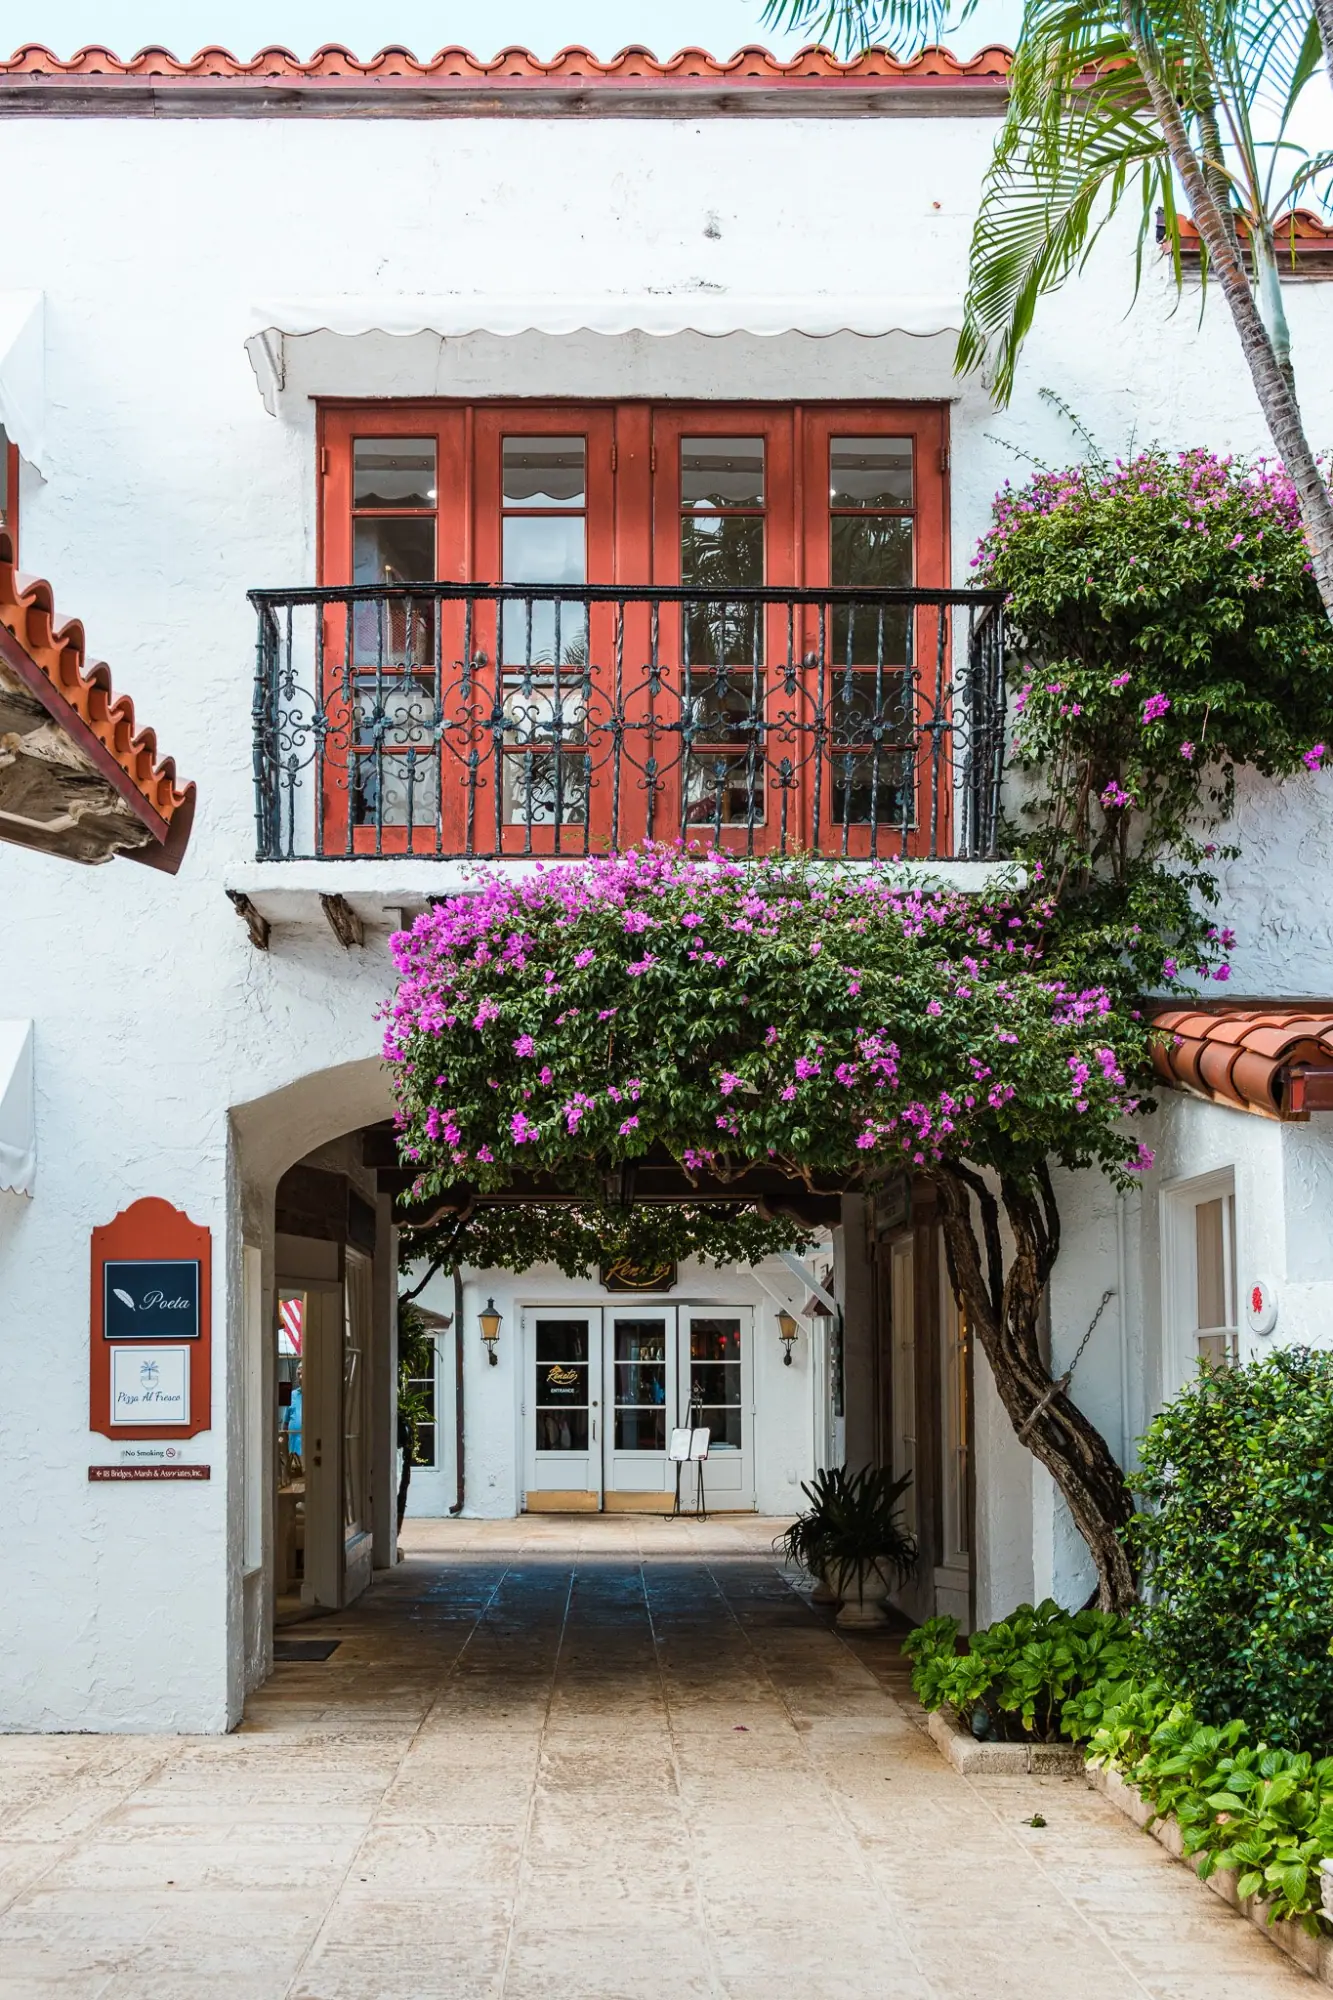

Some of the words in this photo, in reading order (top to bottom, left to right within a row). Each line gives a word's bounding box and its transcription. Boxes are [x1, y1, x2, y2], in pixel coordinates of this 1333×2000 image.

[139, 1290, 190, 1310] Poeta
[117, 1391, 139, 1405] Pizza
[142, 1391, 154, 1402] Al
[155, 1390, 181, 1402] Fresco
[137, 1450, 164, 1458] Smoking
[111, 1470, 133, 1479] Bridges,
